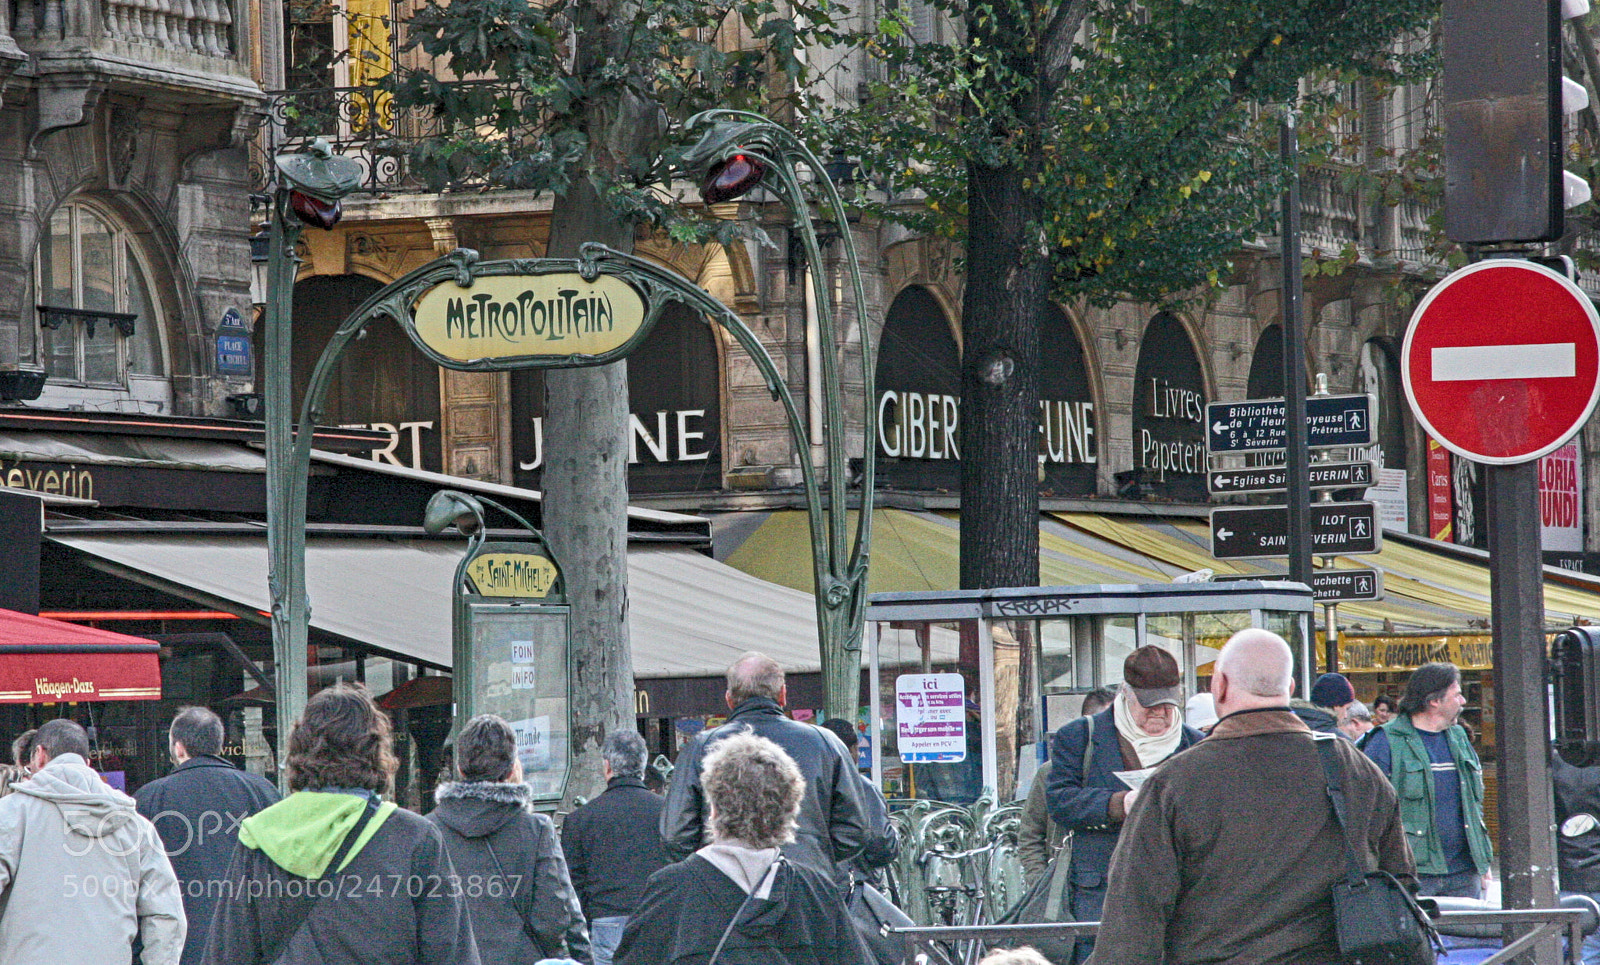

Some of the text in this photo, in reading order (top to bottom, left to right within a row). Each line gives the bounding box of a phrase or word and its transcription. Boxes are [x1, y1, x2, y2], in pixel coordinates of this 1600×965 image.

[223, 341, 242, 351] PLACE
[1151, 377, 1202, 423] Livres
[1229, 405, 1286, 419] Bibliothèq
[878, 389, 961, 461] GIBER
[1229, 419, 1242, 429] de
[1260, 417, 1287, 428] Heur
[1306, 414, 1344, 426] oyeuse
[1229, 425, 1344, 439] 6 à 12 Rue Prêtres
[1245, 437, 1279, 447] Séverin
[1232, 469, 1350, 486] Eglise Sai EVERIN
[1320, 514, 1347, 526] ILOT
[1259, 533, 1347, 547] SAIN VERIN
[1313, 575, 1352, 587] uchette
[1312, 589, 1341, 598] chette
[513, 645, 533, 659] FOIN
[34, 677, 95, 699] Häagen-Dazs
[922, 678, 939, 690] ici
[911, 740, 932, 749] Appeler
[940, 740, 953, 748] PCV
